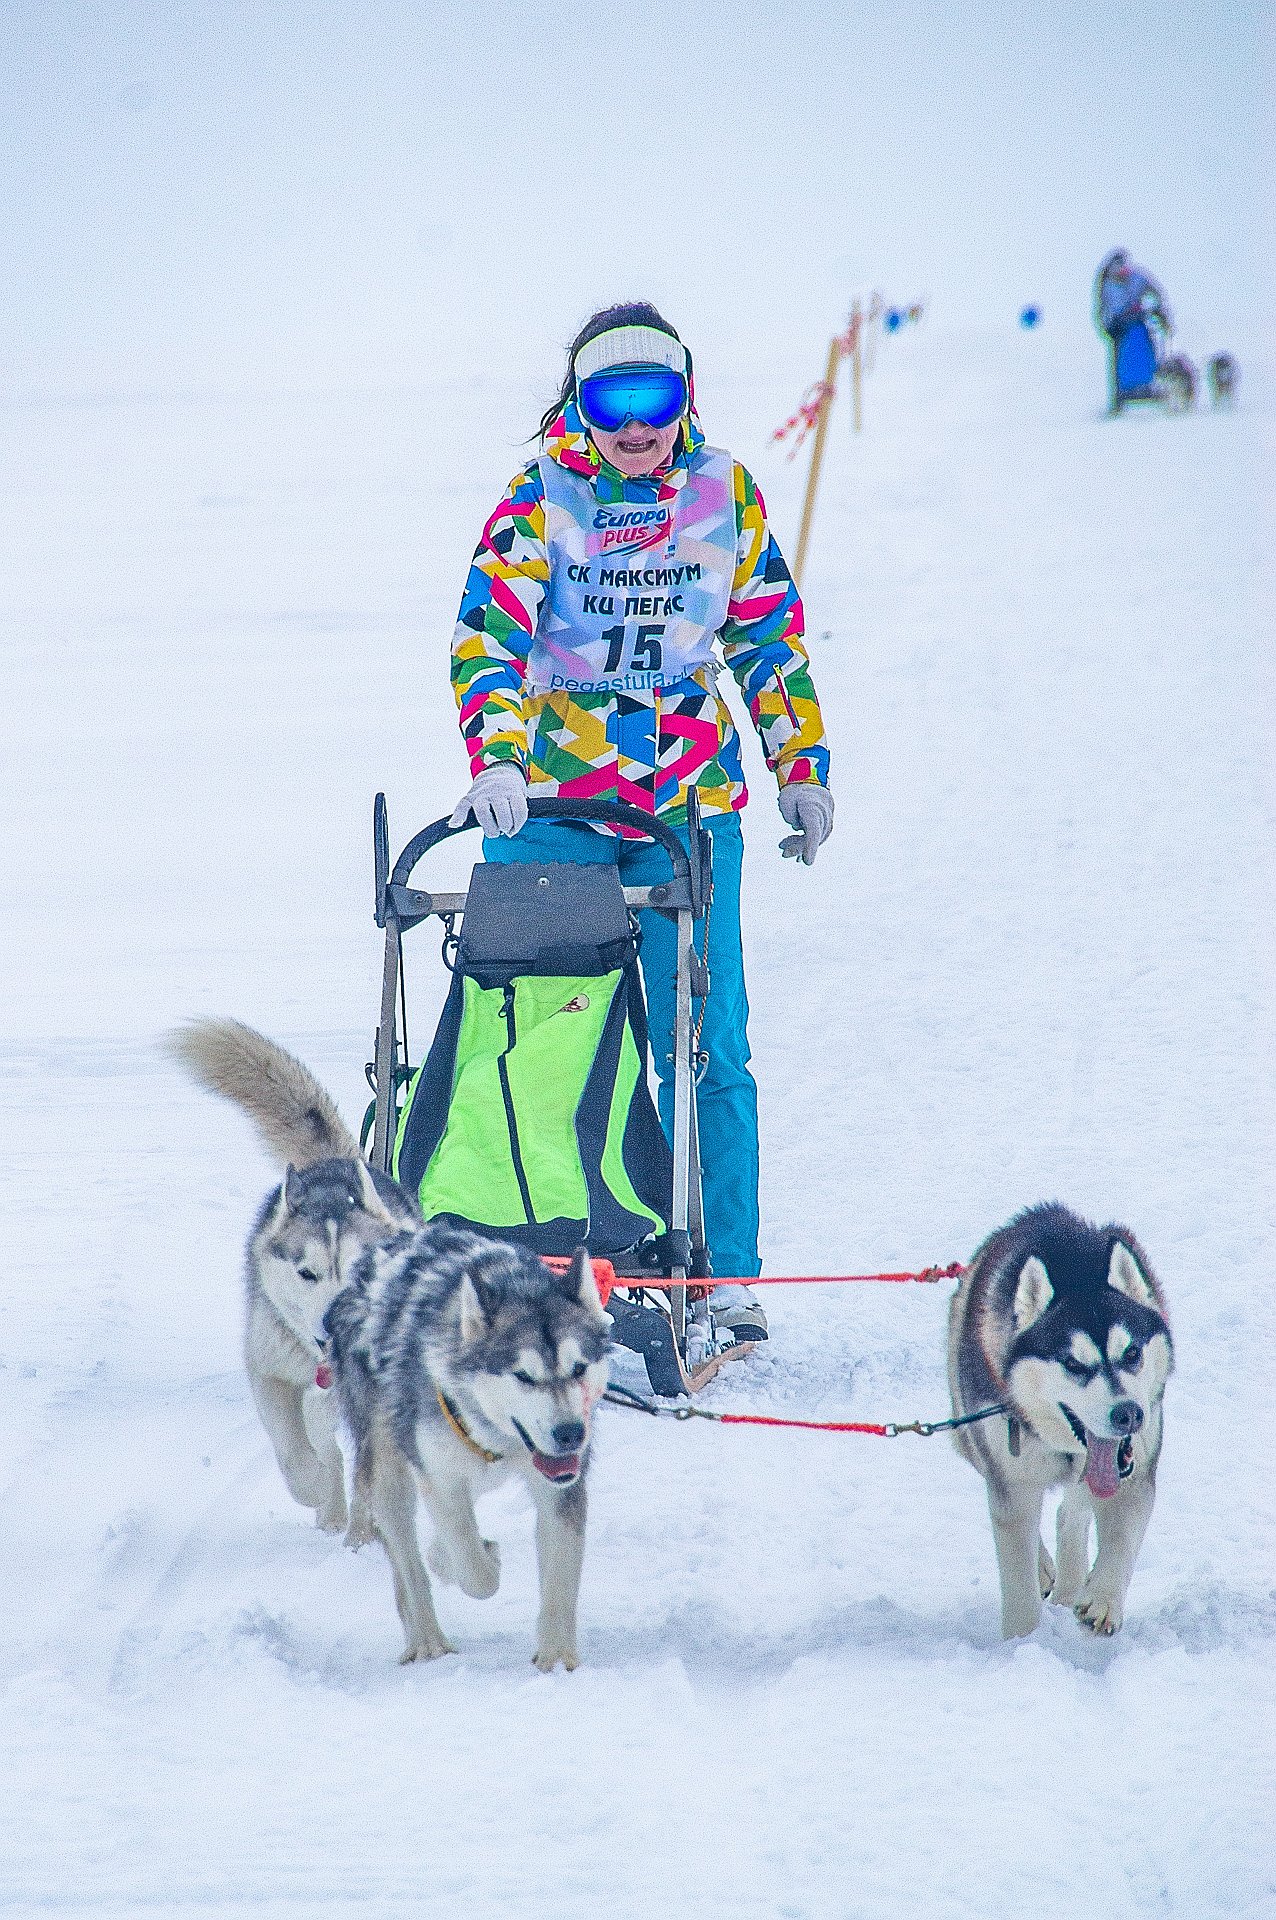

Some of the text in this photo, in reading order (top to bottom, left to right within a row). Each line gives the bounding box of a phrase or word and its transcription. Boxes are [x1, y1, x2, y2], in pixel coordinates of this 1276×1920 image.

[567, 563, 702, 588] СК МАКСИУМ
[582, 594, 685, 617] КЦ ПЕГАС
[601, 624, 666, 673] 15
